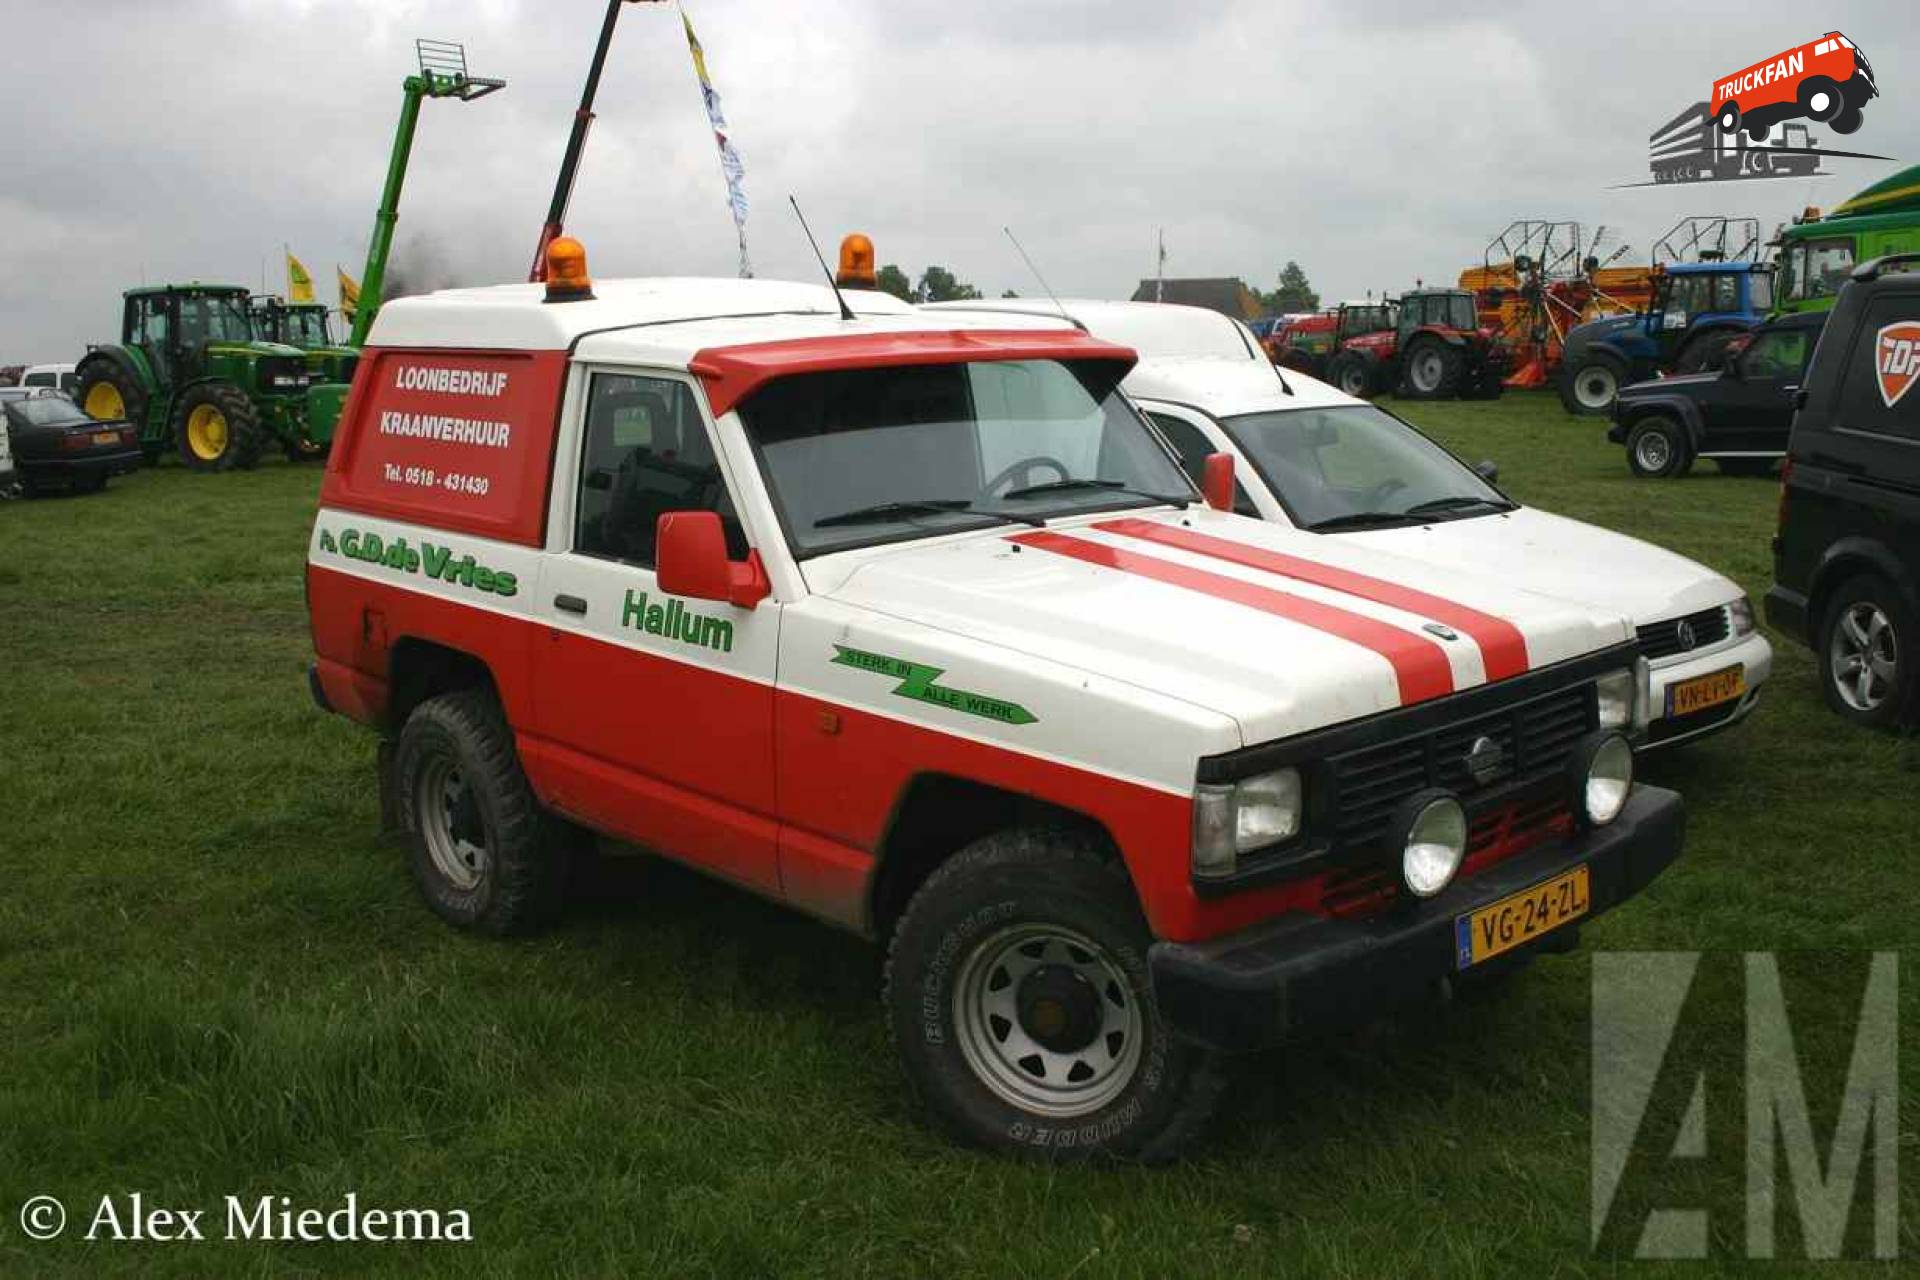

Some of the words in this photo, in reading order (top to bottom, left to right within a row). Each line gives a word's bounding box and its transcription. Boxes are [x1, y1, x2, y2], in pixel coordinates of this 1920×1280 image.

[396, 366, 508, 396] LOONBEDRIJF
[380, 411, 510, 448] KRAANVERHUUR
[384, 463, 402, 482] Tel.
[405, 467, 435, 487] 0518
[444, 473, 489, 495] 431430
[421, 541, 518, 597] Vries
[622, 589, 733, 652] Hallum
[848, 650, 890, 671] STERK
[896, 661, 912, 676] IN
[924, 686, 960, 707] ALLE
[967, 697, 1013, 720] WERK
[1482, 880, 1582, 949] VG-24-ZL
